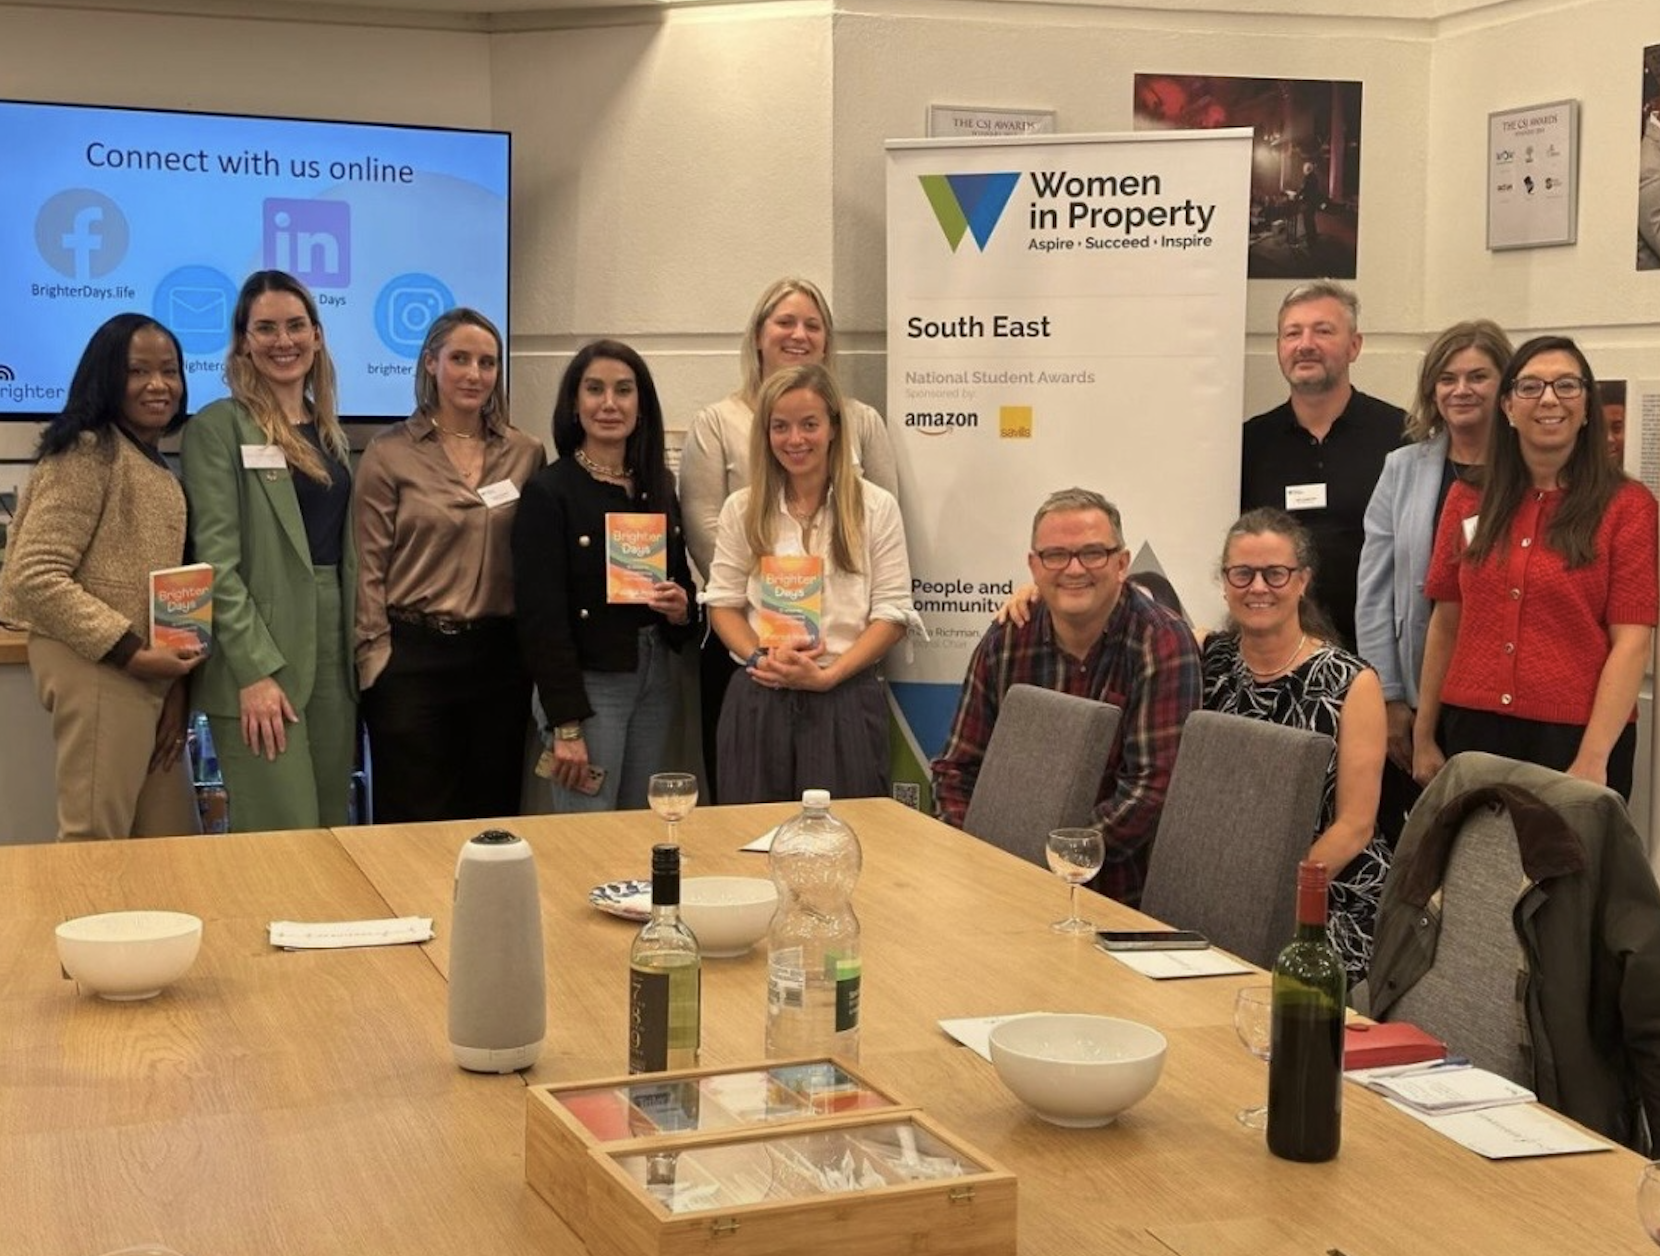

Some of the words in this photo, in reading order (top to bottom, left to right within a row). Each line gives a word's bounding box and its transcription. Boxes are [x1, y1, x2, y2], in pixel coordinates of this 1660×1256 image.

[86, 142, 209, 173] Connect
[217, 150, 280, 176] with
[290, 158, 320, 179] us
[329, 156, 414, 183] online
[1029, 171, 1161, 198] Women
[1029, 202, 1058, 230] in
[1068, 200, 1216, 235] Property
[1028, 238, 1074, 252] Aspire
[1085, 236, 1150, 249] Succeed
[1161, 235, 1213, 251] Inspire
[31, 282, 136, 301] BrighterDays.life
[319, 293, 347, 308] Days
[907, 316, 984, 339] South
[992, 316, 1051, 338] East
[185, 360, 227, 374] ighter
[905, 371, 969, 385] National
[972, 371, 1034, 384] Student
[1037, 371, 1096, 384] Awards
[0, 383, 66, 403] righter
[905, 388, 959, 399] Sponsored
[905, 412, 978, 427] amazon
[1000, 427, 1032, 438] savills
[911, 578, 974, 598] People
[978, 580, 1013, 595] and
[913, 598, 1003, 613] ommunity
